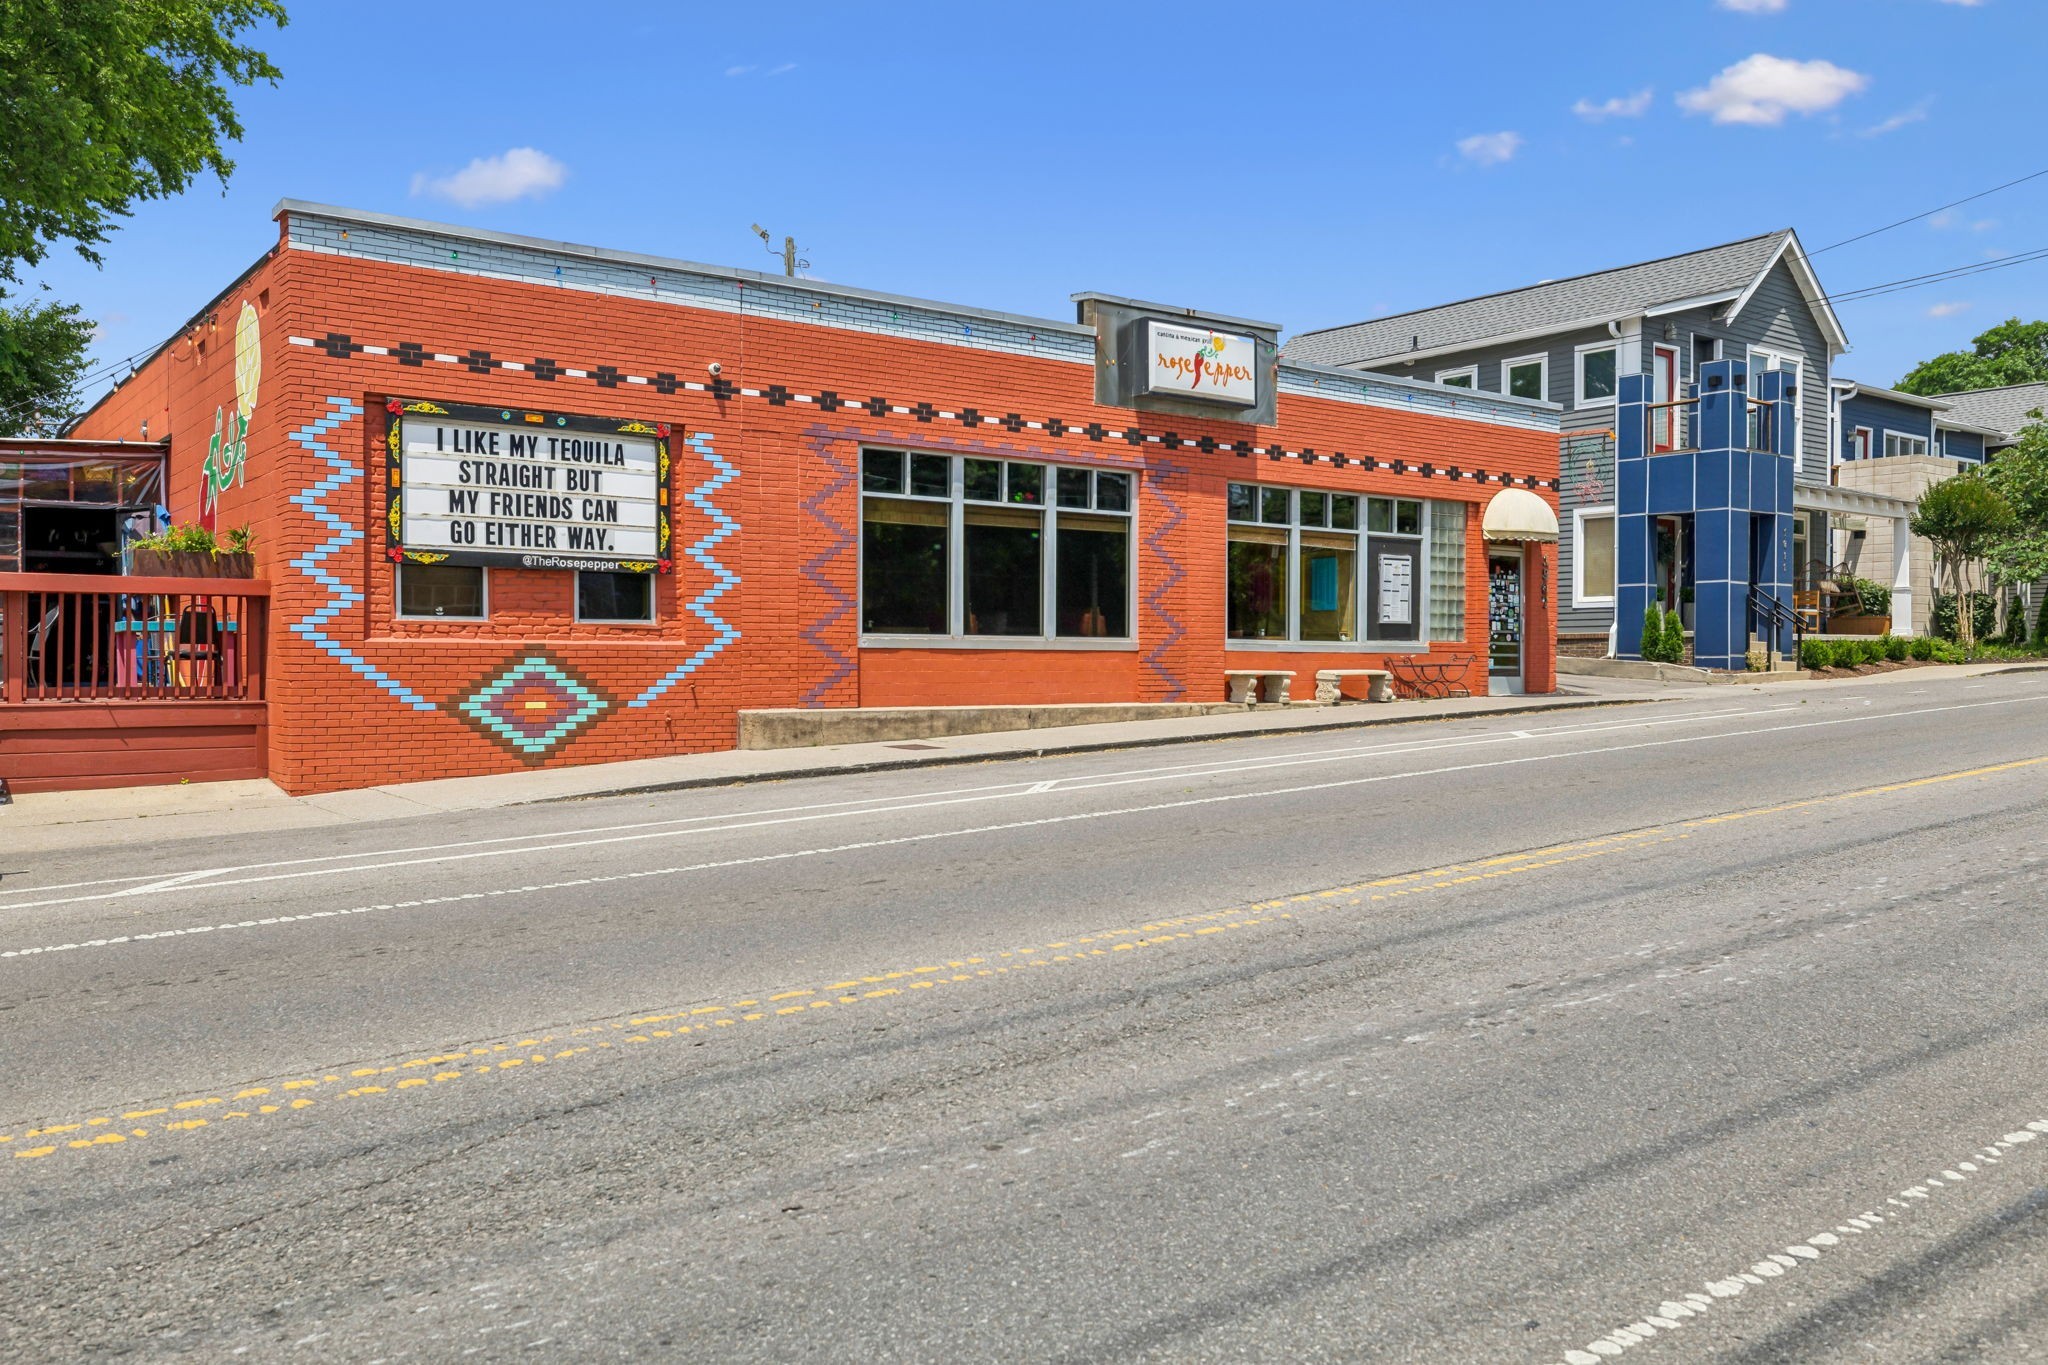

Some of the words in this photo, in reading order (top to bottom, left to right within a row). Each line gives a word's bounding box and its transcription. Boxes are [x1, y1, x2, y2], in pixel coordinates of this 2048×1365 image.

[437, 427, 444, 451] I
[453, 428, 500, 456] LIKE
[509, 433, 539, 459] MY
[548, 437, 625, 466] TEQUILA
[459, 460, 556, 490] STRAIGHT
[567, 468, 603, 493] BUT
[449, 489, 479, 514] MY
[490, 492, 573, 520] FRIENDS
[582, 498, 618, 523] CAN
[450, 520, 475, 545] GO
[485, 521, 557, 549] EITHER
[567, 526, 615, 551] WAY.
[522, 555, 619, 571] @TheRosepepper
